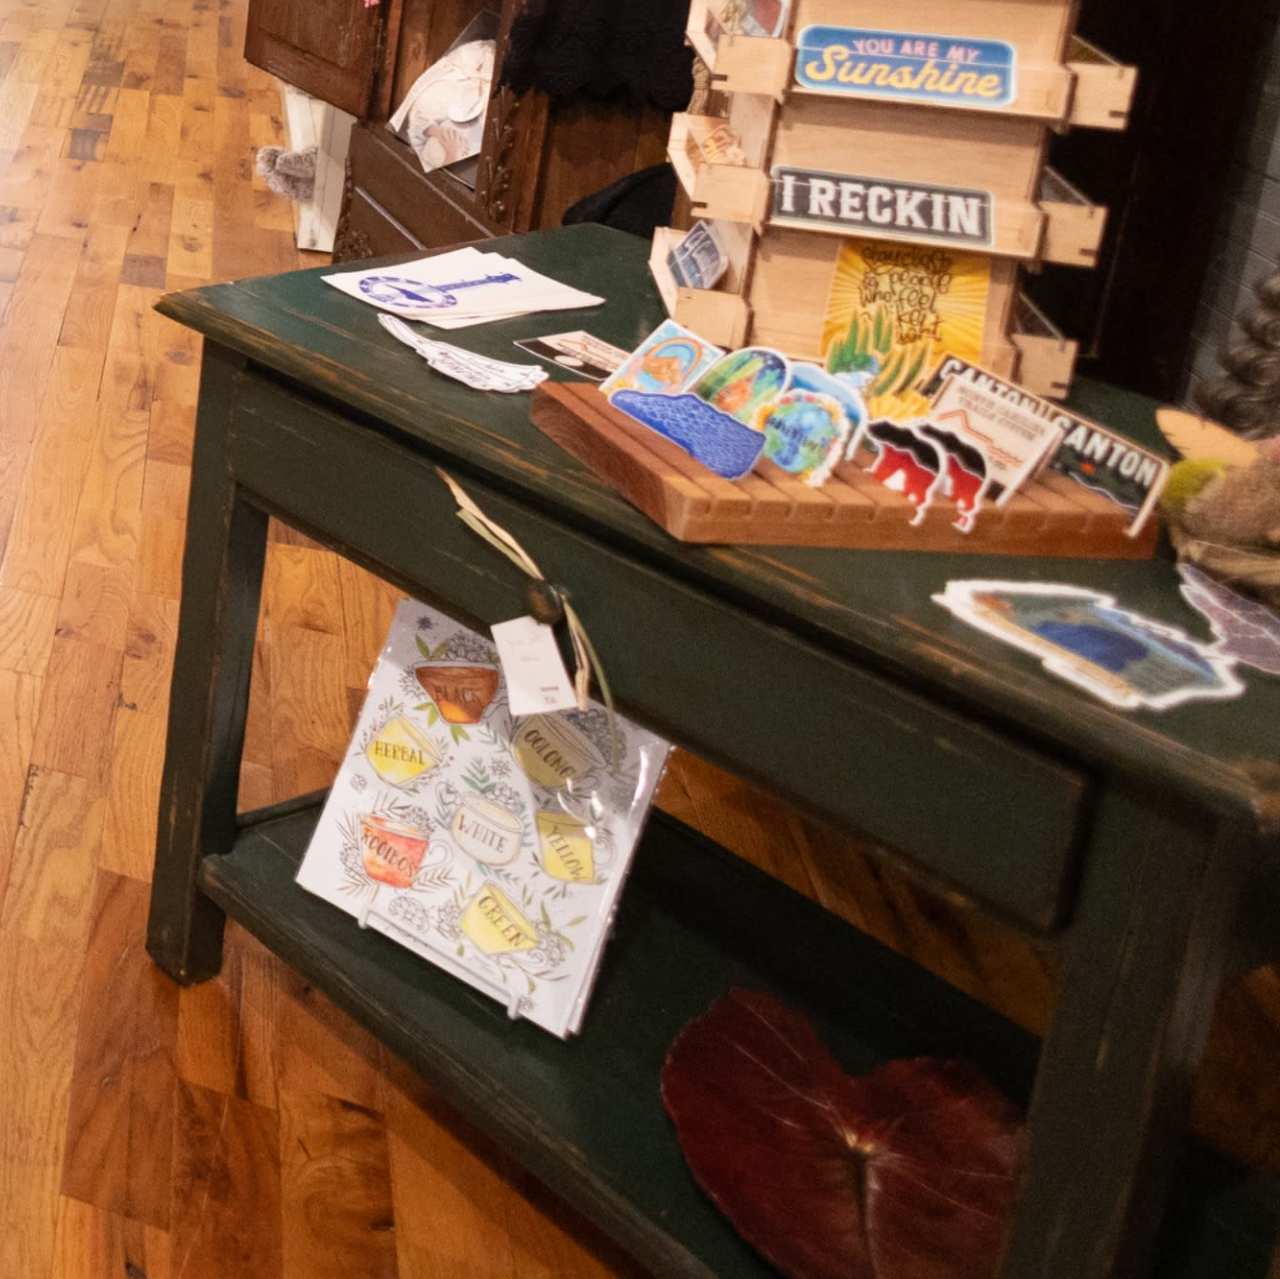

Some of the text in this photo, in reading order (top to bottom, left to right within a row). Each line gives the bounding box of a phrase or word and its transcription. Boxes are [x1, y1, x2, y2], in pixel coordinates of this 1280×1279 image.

[805, 45, 1003, 97] Sunshine
[852, 38, 981, 63] YOU ARE MY
[780, 175, 983, 237] I RECKIN
[1052, 414, 1158, 488] CANTON
[374, 740, 426, 766] HERBAL
[524, 729, 576, 777] OOLONG
[361, 826, 417, 879] ROOIBOS
[457, 814, 508, 854] WHITE
[546, 824, 589, 882] YELLOW
[478, 894, 529, 948] GREEN
